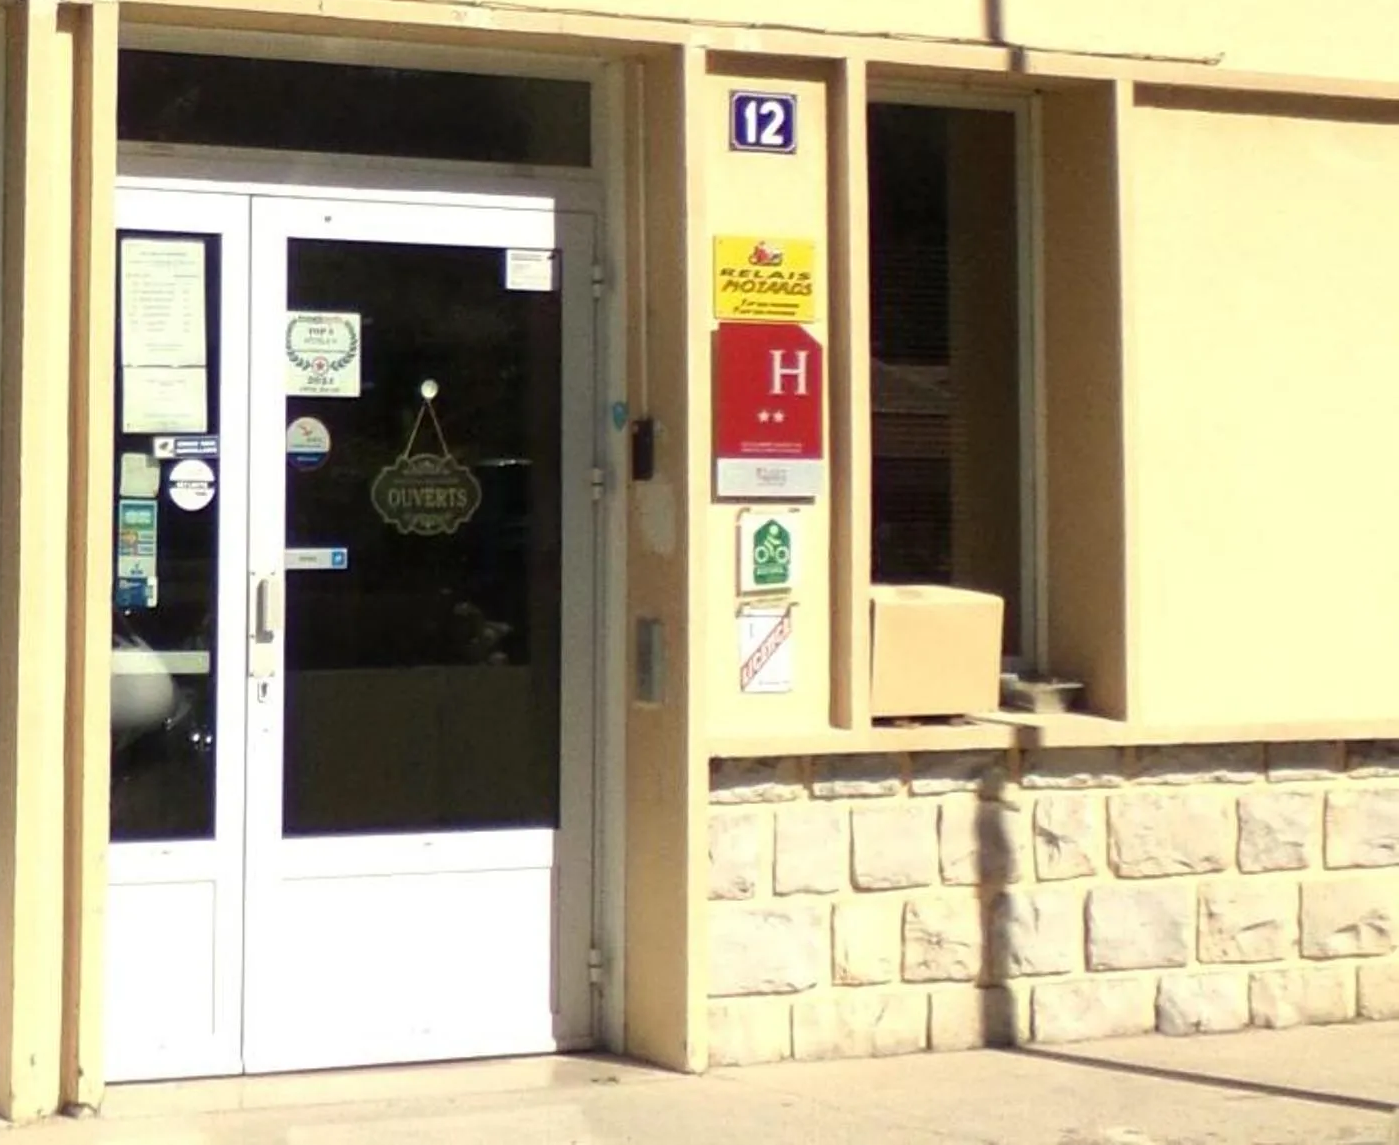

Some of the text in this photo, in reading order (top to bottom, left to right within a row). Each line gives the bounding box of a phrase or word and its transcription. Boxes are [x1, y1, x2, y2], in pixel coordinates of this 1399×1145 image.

[744, 100, 785, 146] 12
[719, 267, 812, 281] RELAIS
[768, 348, 810, 396] H
[387, 486, 468, 508] OUVERTS
